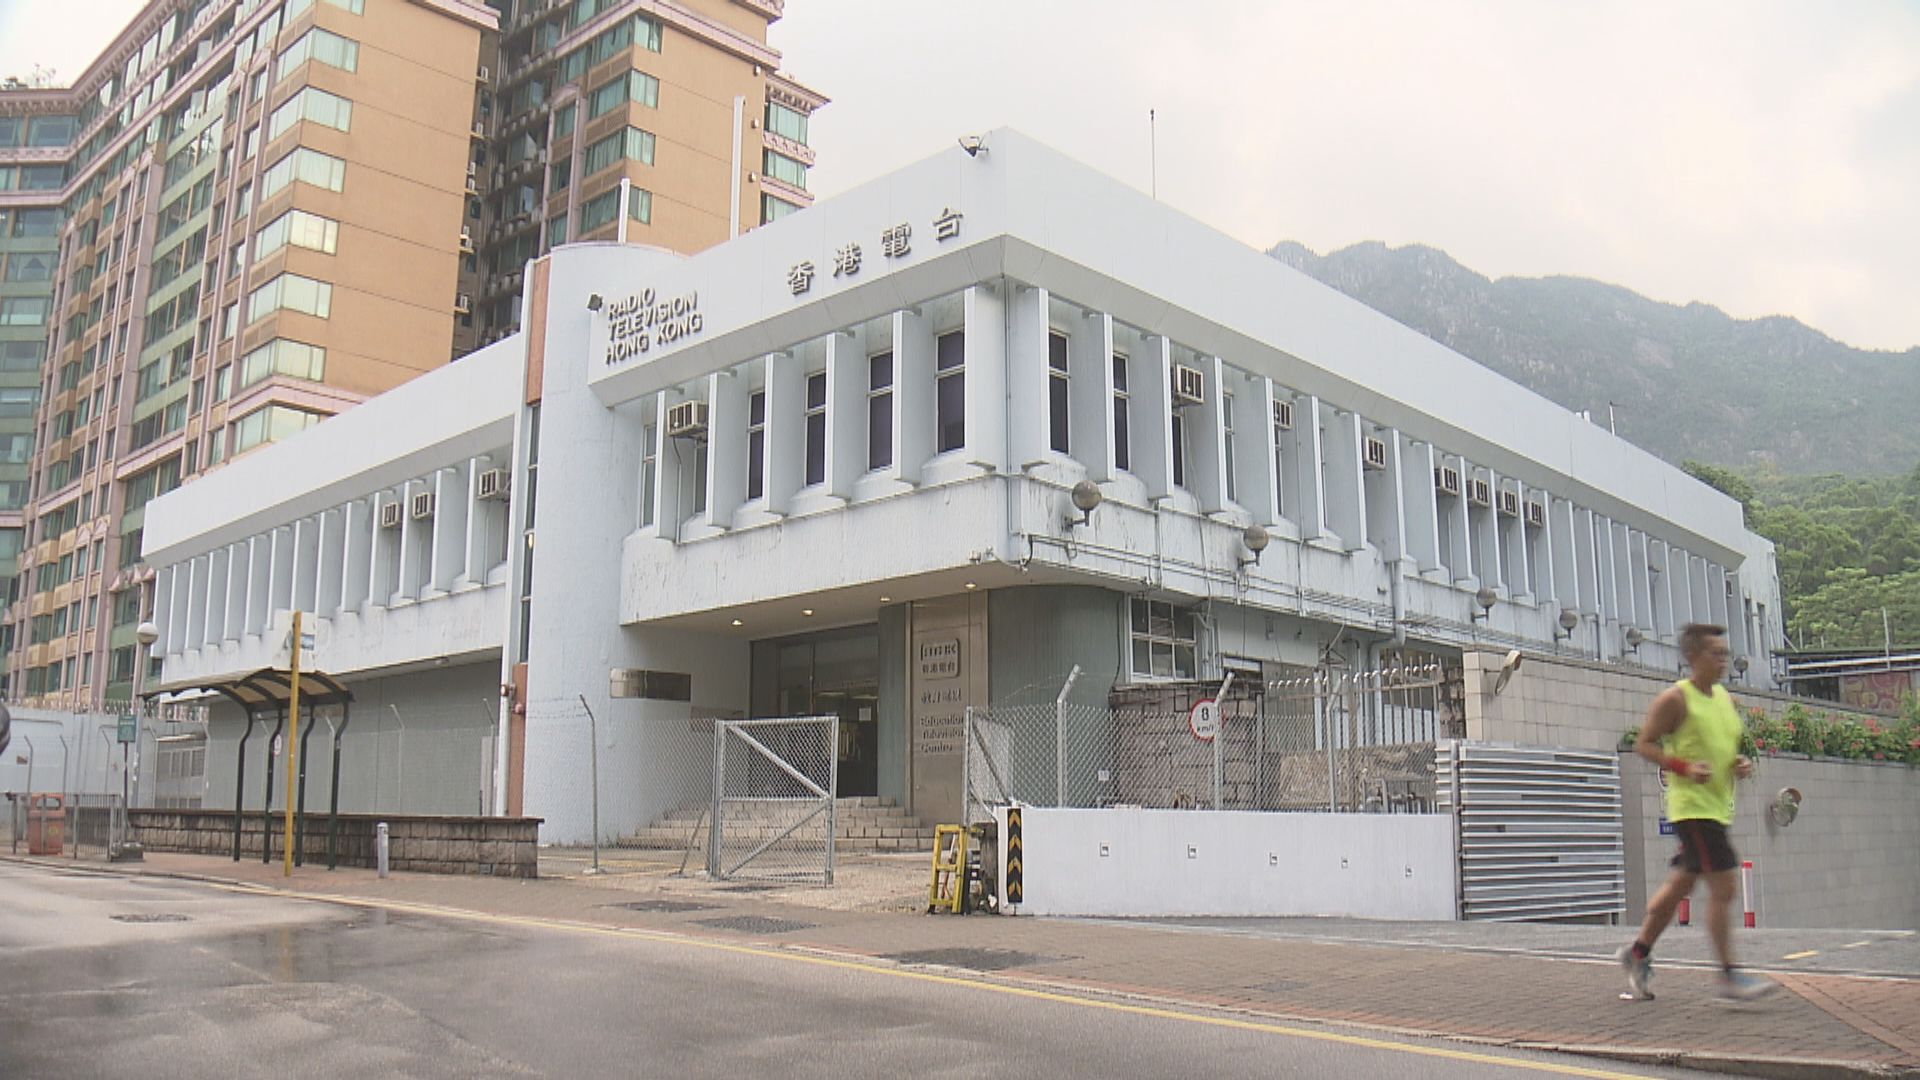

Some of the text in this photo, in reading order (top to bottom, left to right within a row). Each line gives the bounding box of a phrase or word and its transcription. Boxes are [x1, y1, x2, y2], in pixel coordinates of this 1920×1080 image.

[788, 207, 963, 295] 香港電台
[608, 286, 656, 321] RADIO
[608, 289, 698, 343] TELEVISION
[606, 312, 703, 365] HONG KONG
[1201, 706, 1210, 721] 8
